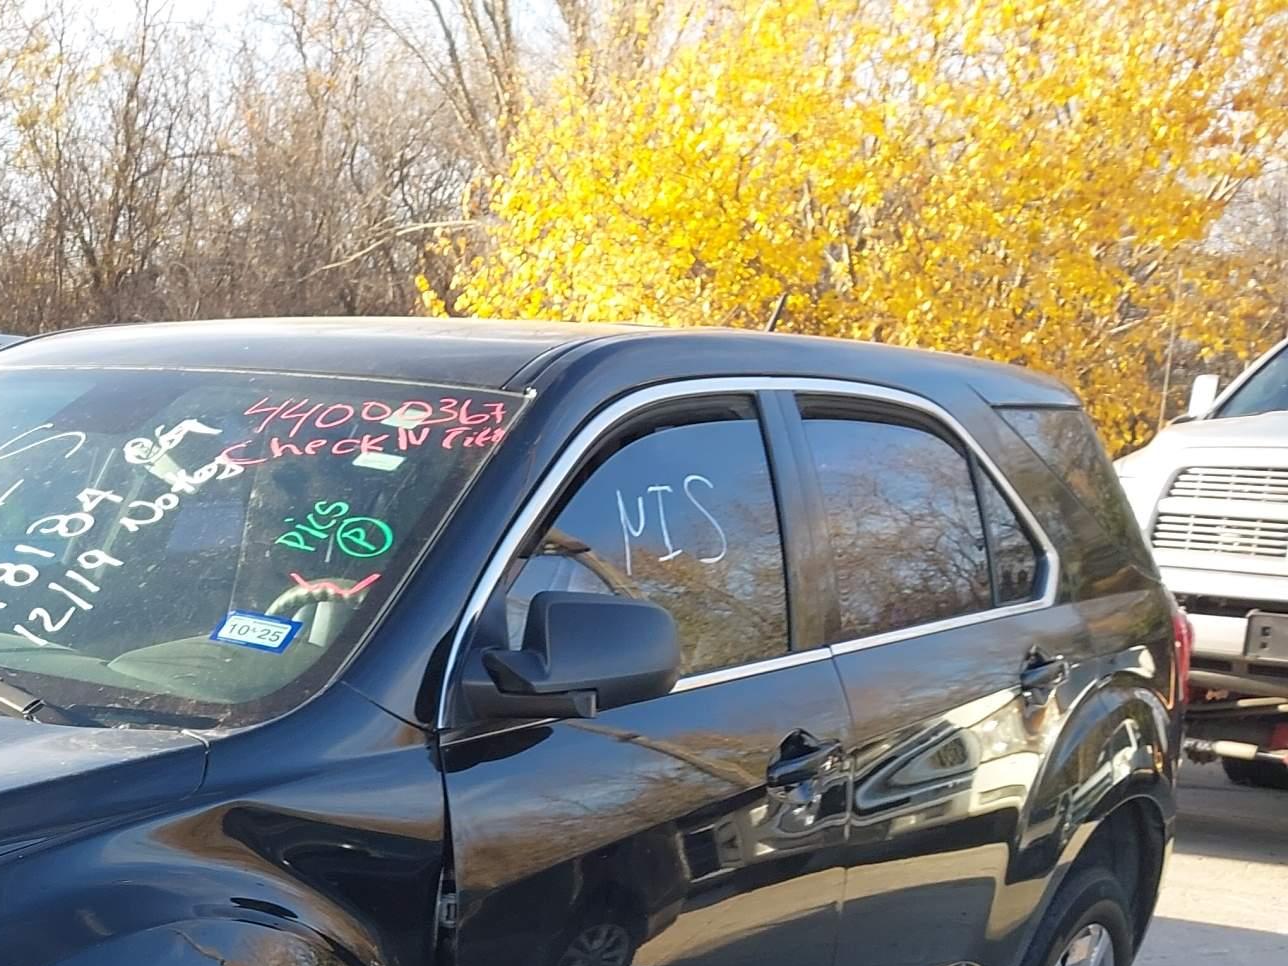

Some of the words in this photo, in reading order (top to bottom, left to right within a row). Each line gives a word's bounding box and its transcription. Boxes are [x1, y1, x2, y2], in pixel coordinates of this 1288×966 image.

[244, 396, 506, 438] 44000367
[615, 474, 727, 575] NIS
[13, 549, 124, 647] 12/19
[228, 623, 251, 637] 10
[256, 628, 284, 643] 25
